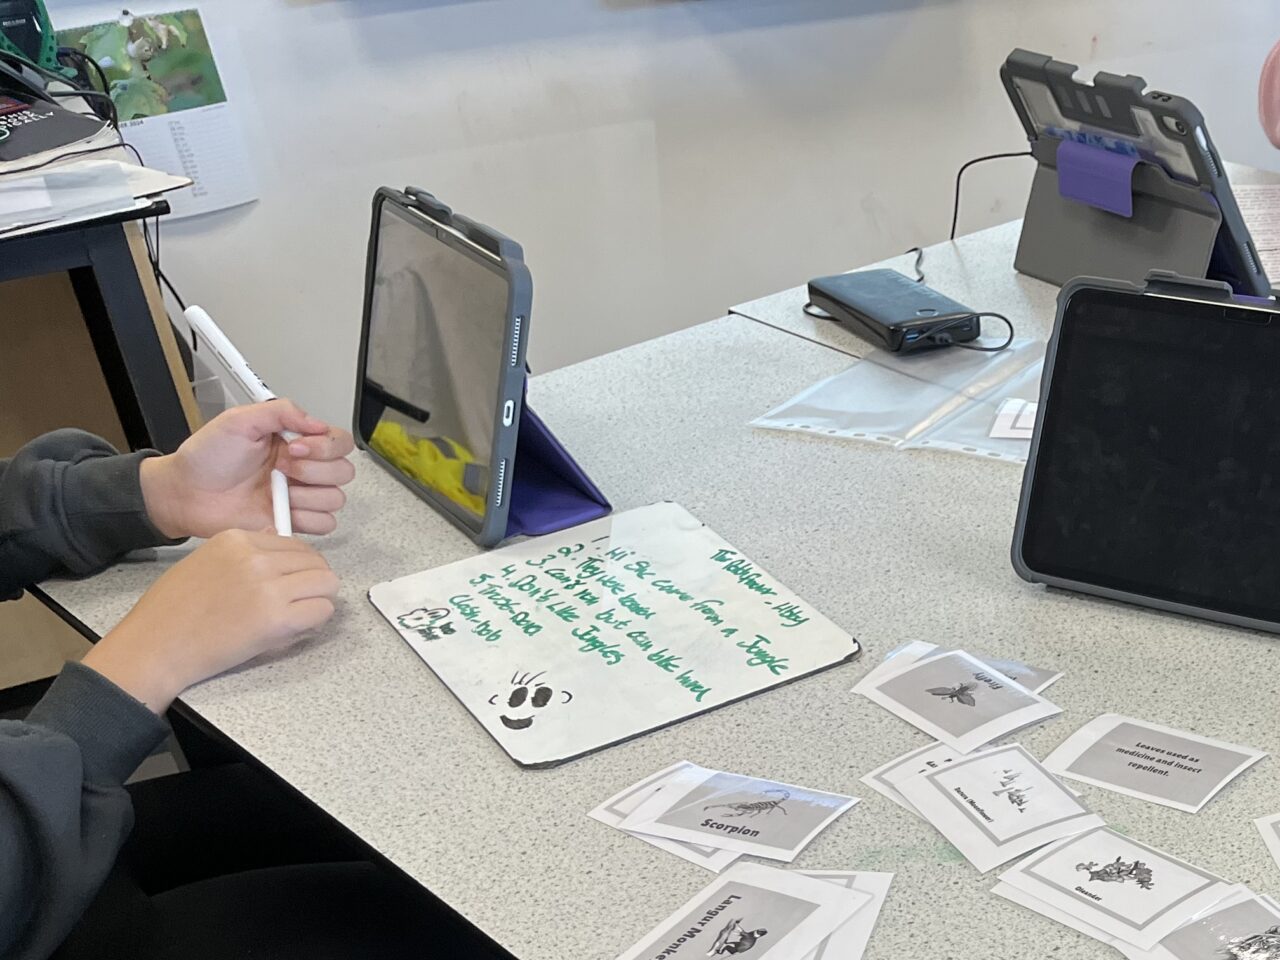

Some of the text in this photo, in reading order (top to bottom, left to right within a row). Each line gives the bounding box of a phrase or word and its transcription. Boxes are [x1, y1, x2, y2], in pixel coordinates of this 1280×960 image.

[1116, 747, 1203, 774] medicine and insect
[1135, 742, 1166, 754] Leaves
[1166, 750, 1189, 760] used
[700, 818, 761, 838] Scorpion
[697, 894, 742, 928] Langur
